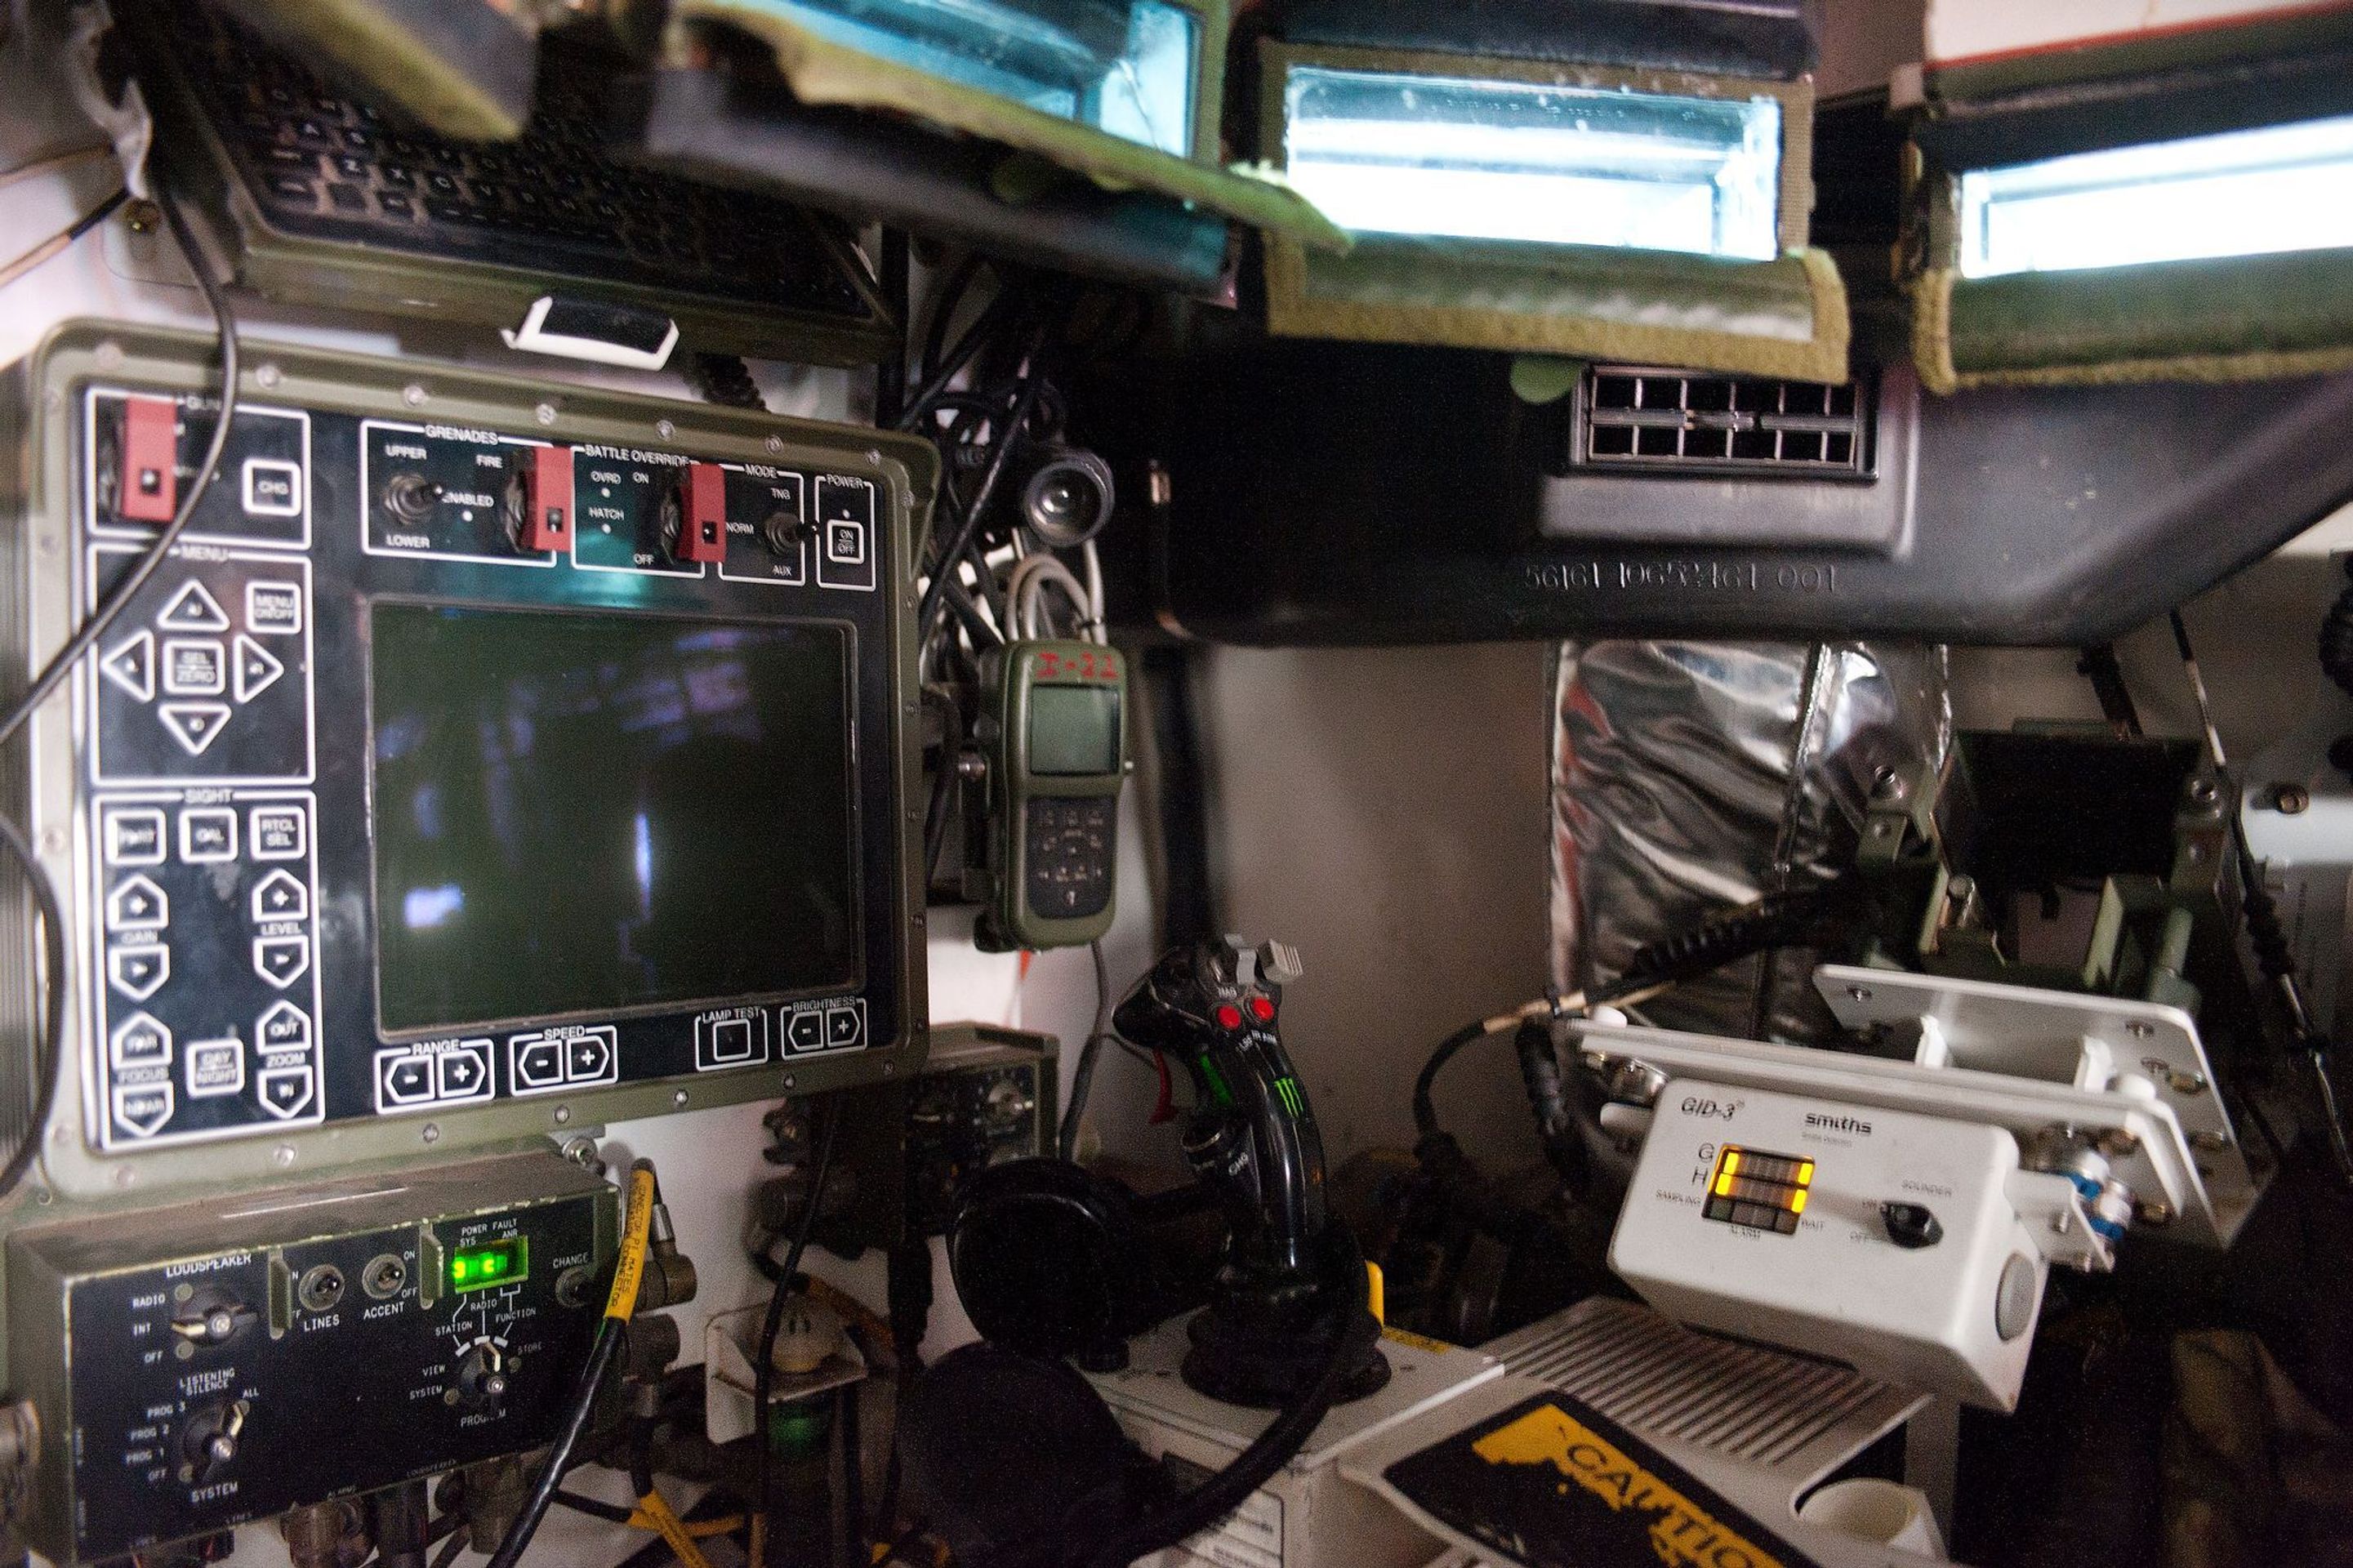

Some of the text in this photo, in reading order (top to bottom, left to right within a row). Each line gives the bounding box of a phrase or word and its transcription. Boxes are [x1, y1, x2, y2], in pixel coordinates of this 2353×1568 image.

[425, 425, 498, 446] GRENADES
[385, 444, 427, 460] UPPER
[585, 444, 630, 461] BATTLE
[476, 455, 502, 468] FIRE
[632, 471, 649, 483] ON
[745, 464, 777, 479] MODE
[827, 474, 863, 489] POWER
[588, 506, 625, 521] HATCH
[725, 522, 755, 535] NORM
[839, 529, 853, 540] ON
[385, 533, 430, 548] LOWER
[838, 542, 855, 554] OFF
[180, 545, 229, 563] MENU
[633, 553, 654, 565] OFF
[772, 564, 792, 577] AUX
[184, 789, 234, 804] SIGHT
[261, 922, 302, 935] LEVEL
[792, 996, 856, 1013] BRIGHTNESS
[702, 1006, 761, 1024] LAMP TEST
[544, 1026, 586, 1040] SPEED
[412, 1039, 461, 1056] RANGE
[265, 1053, 305, 1067] ZOOM
[1805, 1113, 1872, 1134] smiths
[1699, 1143, 1714, 1163] G
[1691, 1165, 1708, 1186] H
[461, 1218, 518, 1236] POWER FAULT
[460, 1236, 476, 1248] SYS
[403, 1250, 417, 1261] ON
[553, 1251, 589, 1269] CHANGE
[166, 1252, 252, 1279] LOUDSPEAKER
[401, 1286, 419, 1298] OFF
[132, 1293, 166, 1308] RADIO
[470, 1298, 497, 1312] RADIO
[363, 1300, 405, 1321] ACCENT
[495, 1307, 537, 1323] FUNCTION
[133, 1322, 152, 1338] INT
[304, 1313, 341, 1333] LINES
[435, 1321, 473, 1337] STATION
[144, 1350, 163, 1365] OFF
[180, 1367, 235, 1389] LISTENING
[422, 1364, 446, 1378] VIEW
[186, 1379, 230, 1397] SILENCE
[243, 1386, 260, 1399] ALL
[409, 1384, 443, 1401] SYSTEM
[460, 1407, 506, 1428] PROGM
[191, 1480, 238, 1503] SYSTEM
